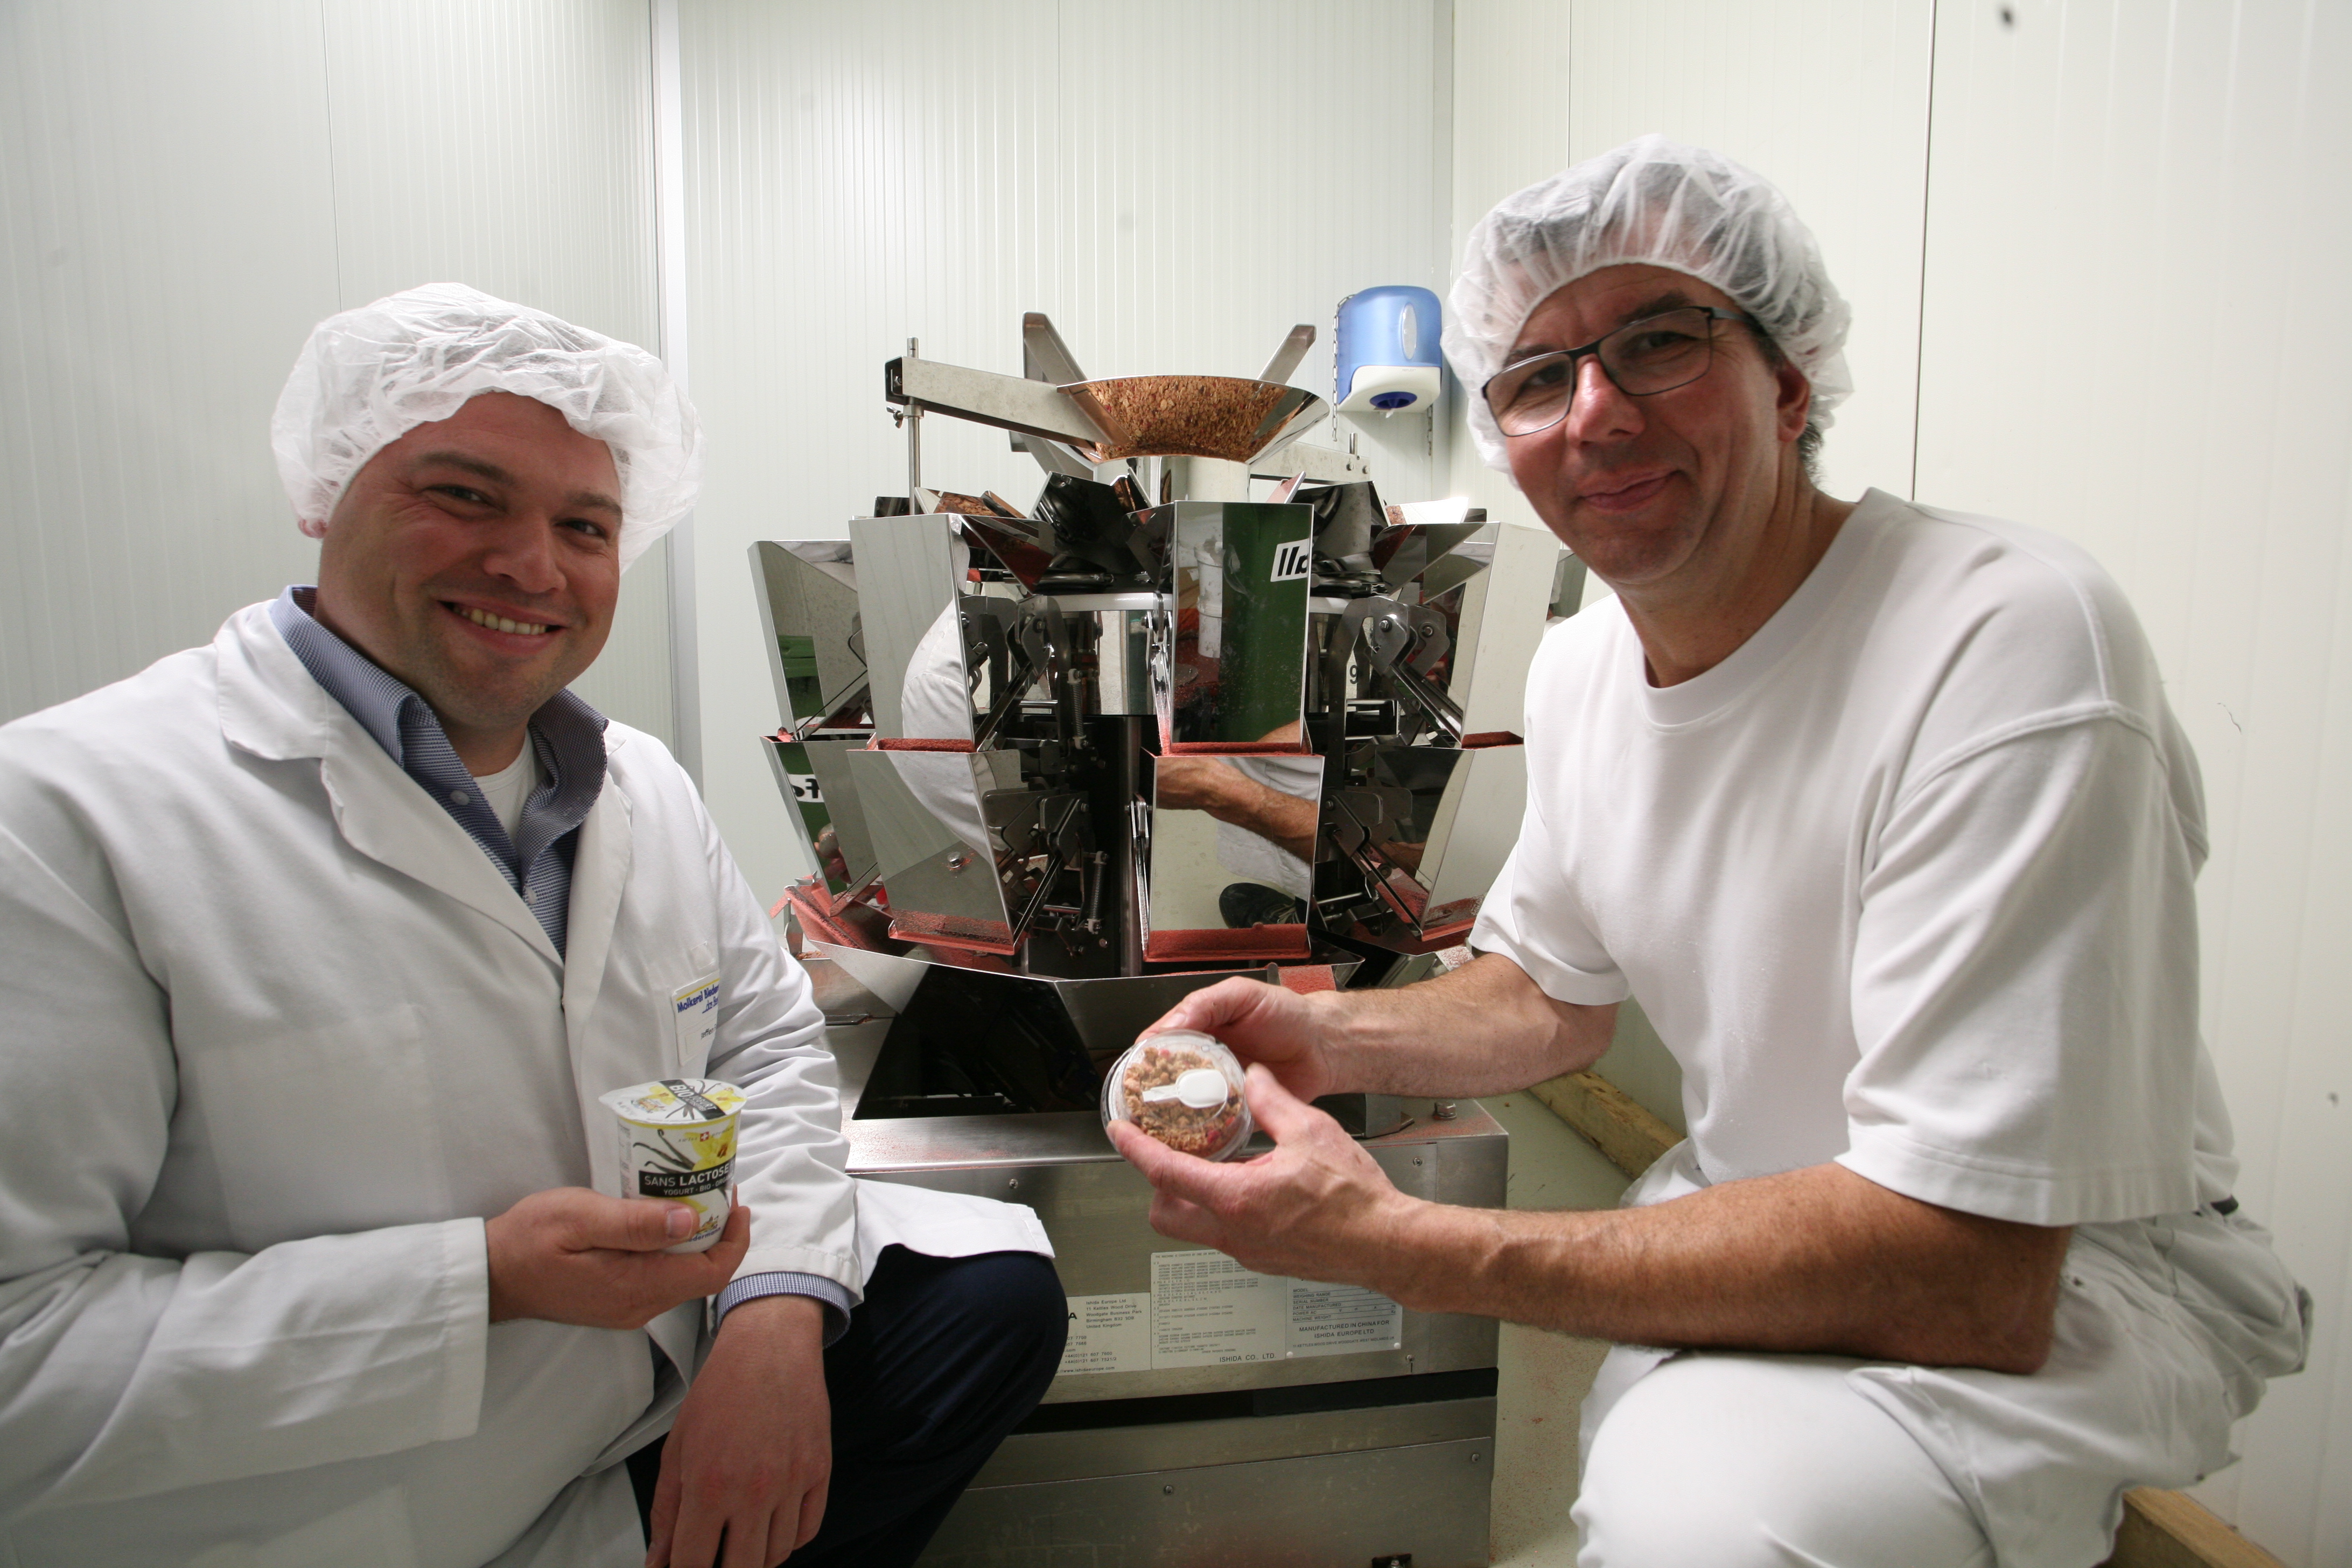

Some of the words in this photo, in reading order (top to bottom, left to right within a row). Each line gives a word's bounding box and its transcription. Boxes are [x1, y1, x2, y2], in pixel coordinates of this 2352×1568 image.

[1349, 665, 1358, 684] 9
[669, 1084, 695, 1097] BIO
[645, 1175, 675, 1187] SANS
[680, 1164, 729, 1187] LACTOSE
[664, 1187, 694, 1195] YOGURT
[700, 1184, 711, 1192] BIO
[687, 1227, 720, 1242] edermann
[1299, 1323, 1349, 1332] MANUFACTURED
